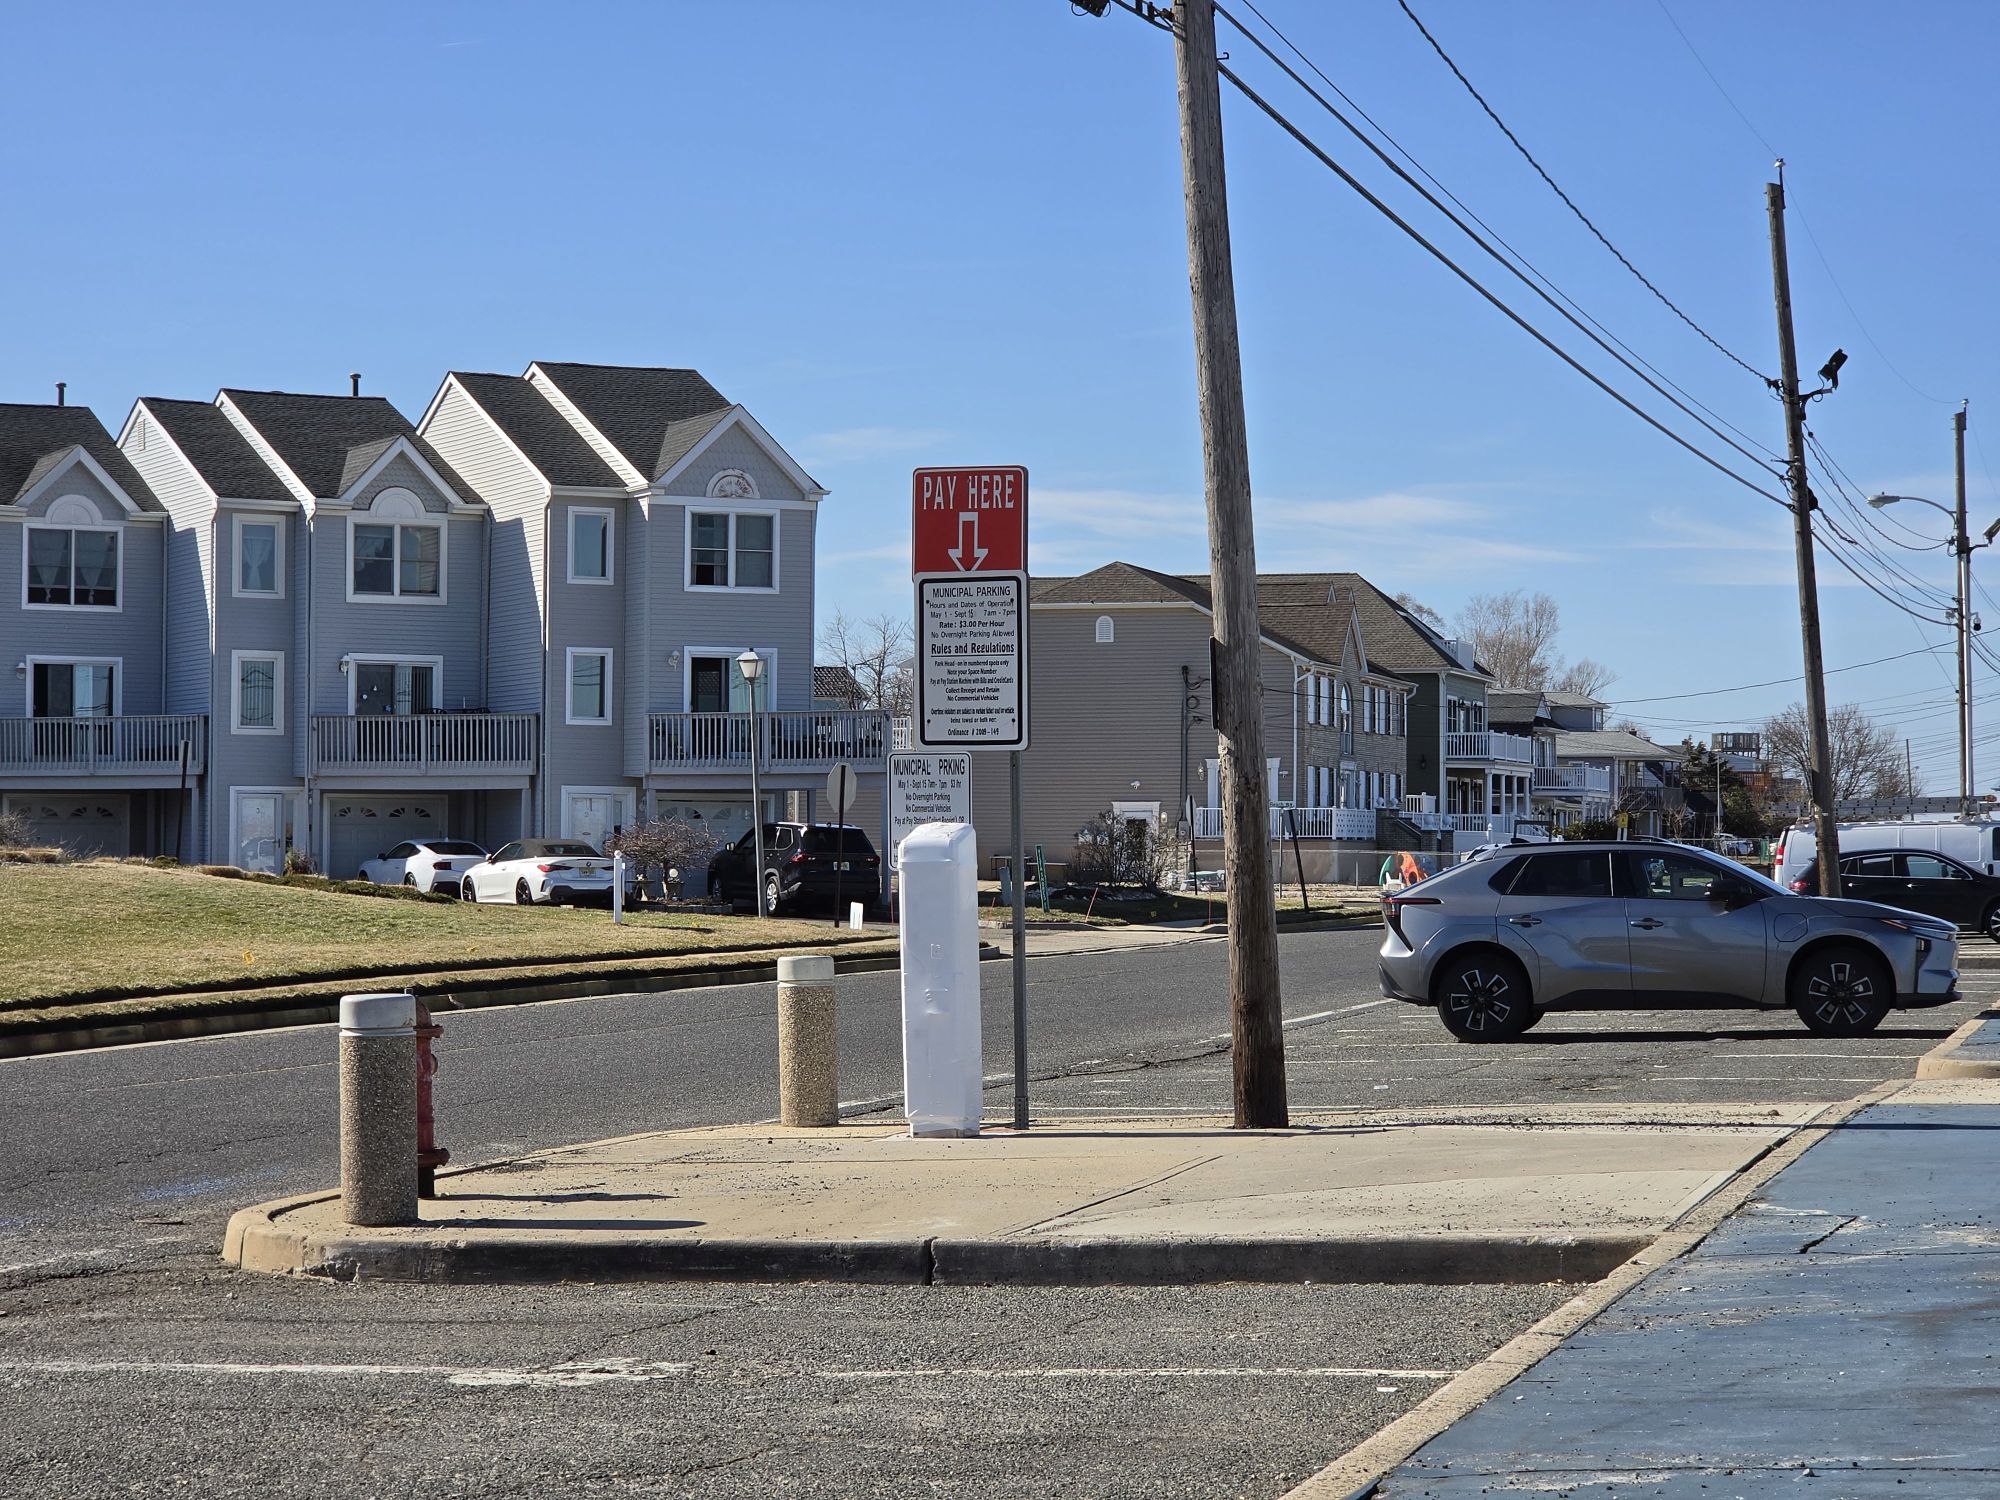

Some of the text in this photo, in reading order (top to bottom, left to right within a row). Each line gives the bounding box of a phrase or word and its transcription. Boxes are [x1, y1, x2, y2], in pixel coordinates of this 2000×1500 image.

[924, 474, 1014, 510] PAY HERE
[933, 586, 1010, 598] MUNICIPAL PARKING
[968, 609, 973, 618] 15
[932, 642, 1014, 654] Rules and Regulations
[894, 759, 965, 775] MUNICIPAL PRKING
[912, 780, 921, 790] Sept
[922, 780, 926, 788] 15
[939, 780, 947, 790] 7pm
[951, 780, 955, 788] $3
[913, 793, 933, 802] Overnight
[934, 793, 950, 802] Parking
[912, 804, 934, 813] Commercial
[935, 804, 951, 813] Vehicles
